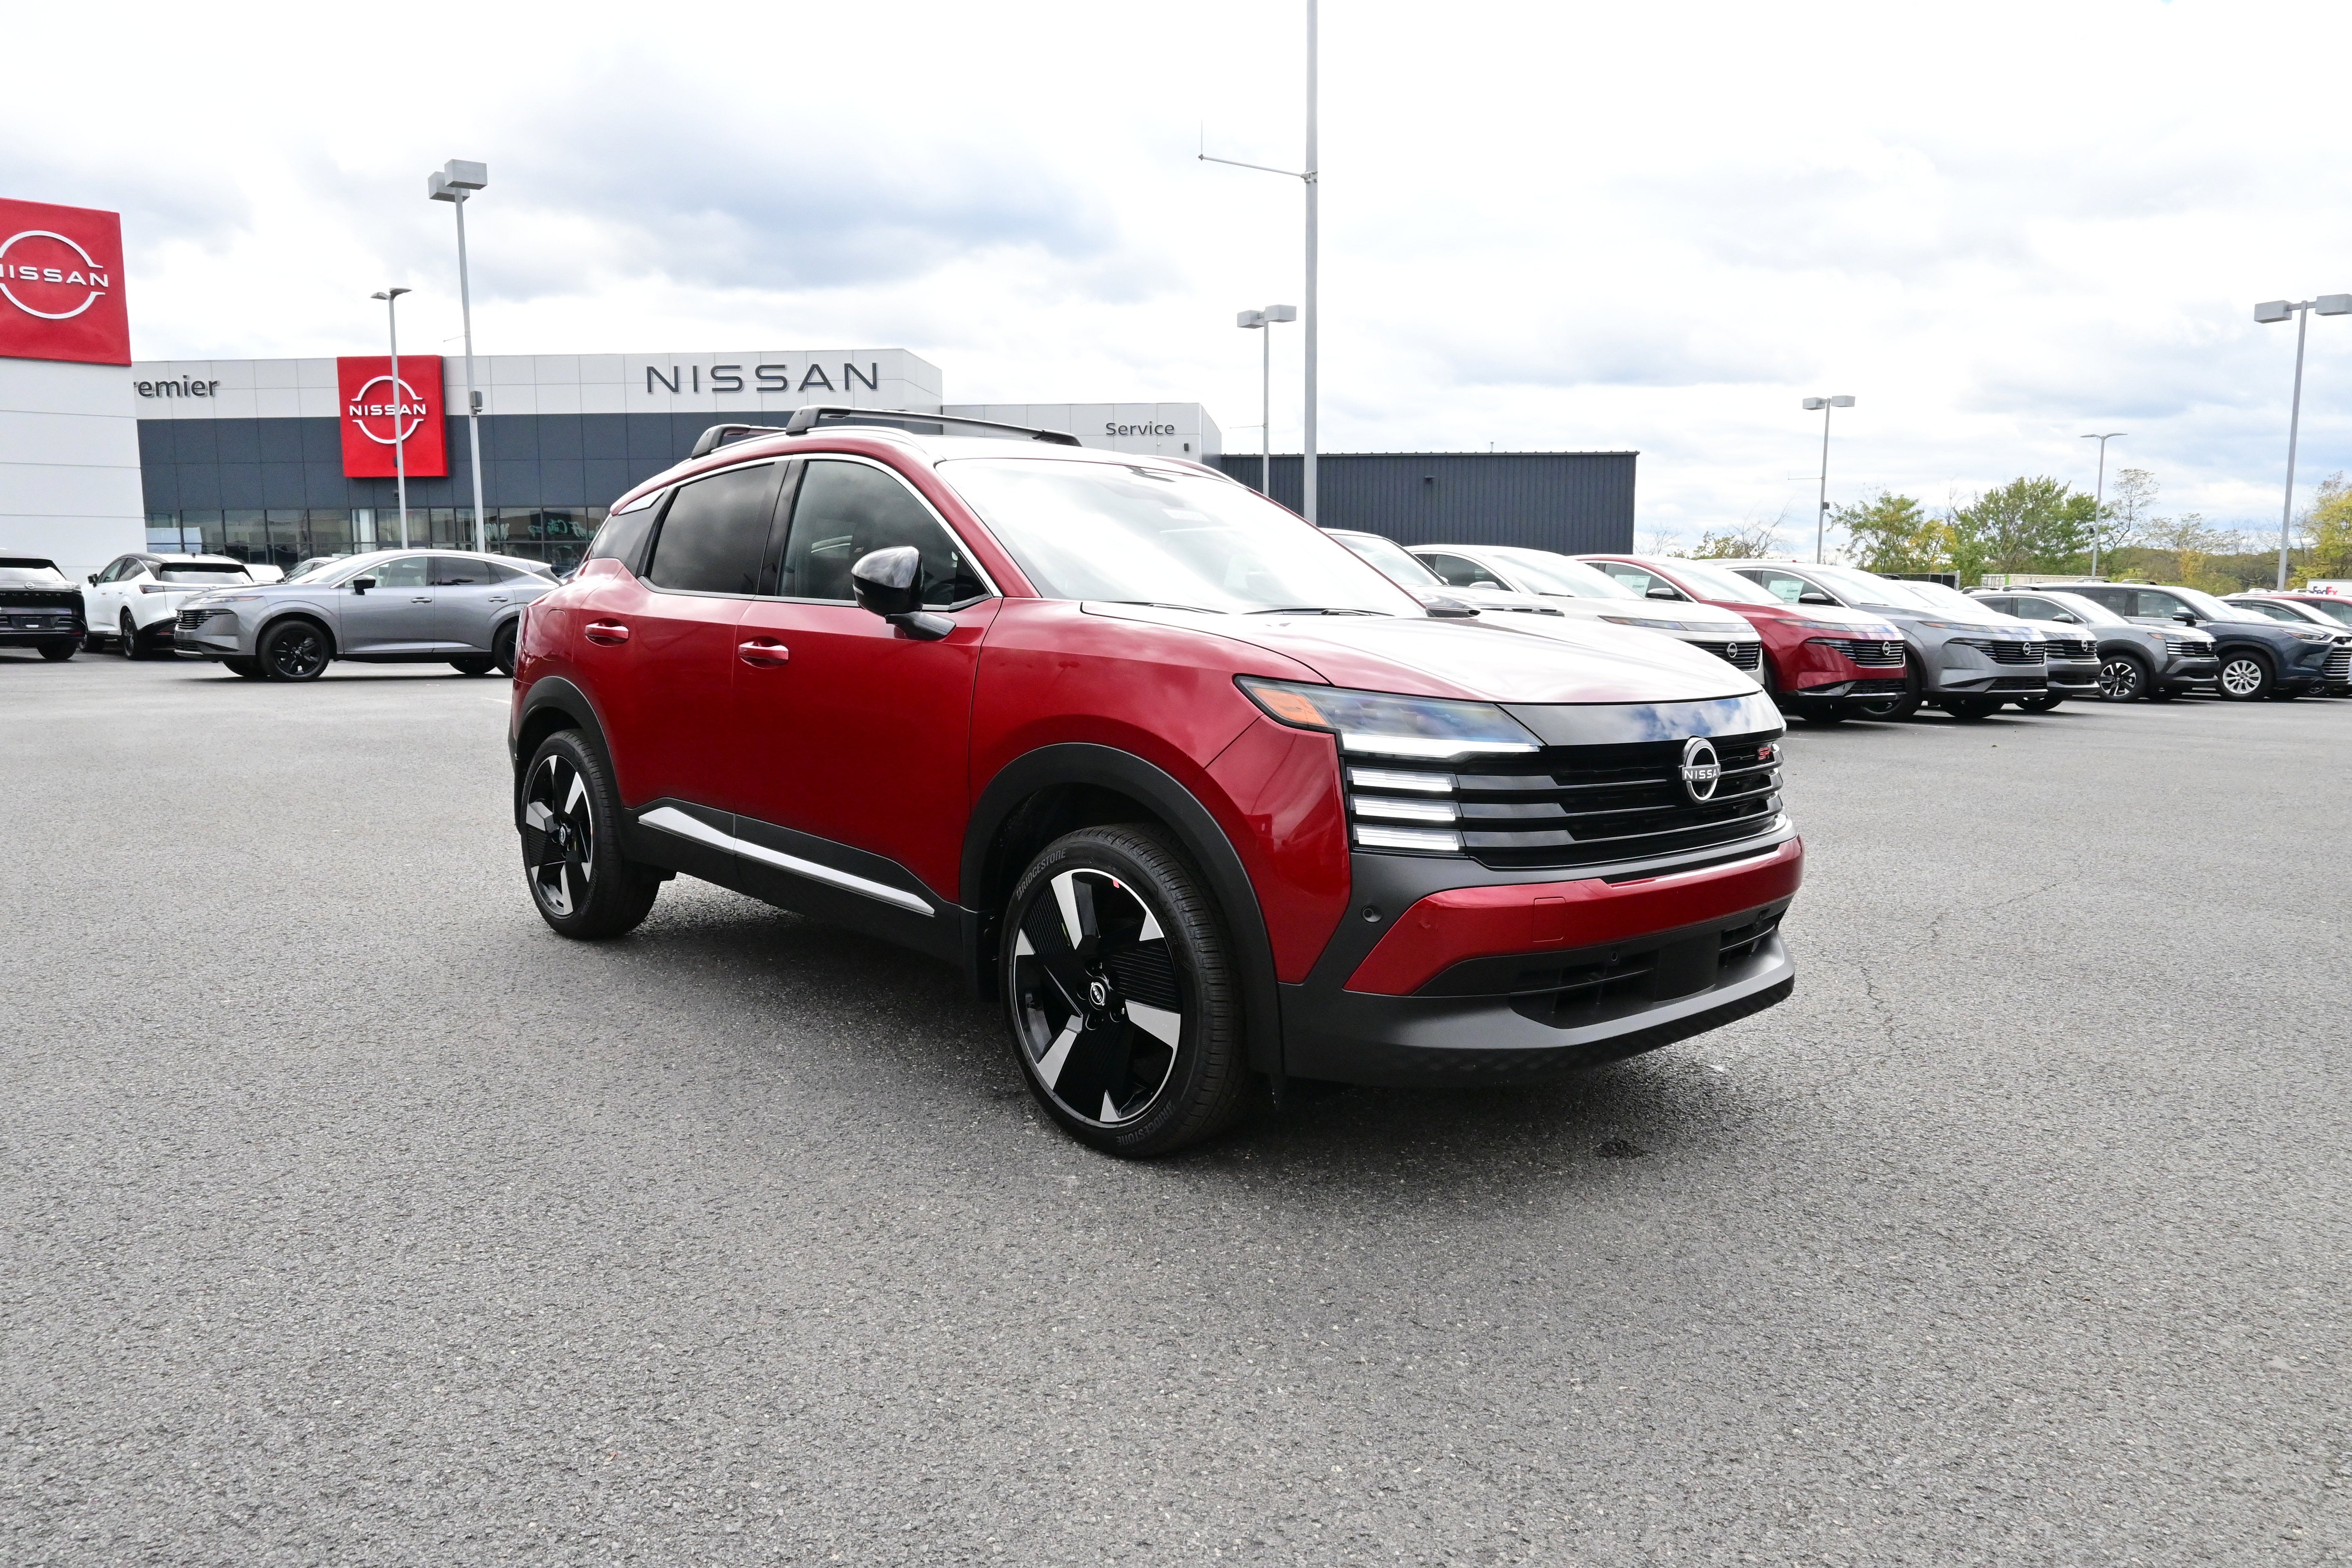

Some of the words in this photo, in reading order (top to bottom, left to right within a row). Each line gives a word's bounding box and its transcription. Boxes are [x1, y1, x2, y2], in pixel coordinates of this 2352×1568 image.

[0, 264, 109, 287] ISSAN
[133, 375, 219, 397] emier
[646, 362, 878, 393] NISSAN
[349, 404, 426, 416] NISSAN
[1106, 421, 1175, 436] Service
[1016, 848, 1067, 901] BRIDGESTONE
[1116, 1100, 1176, 1146] BRIDGESTONE
